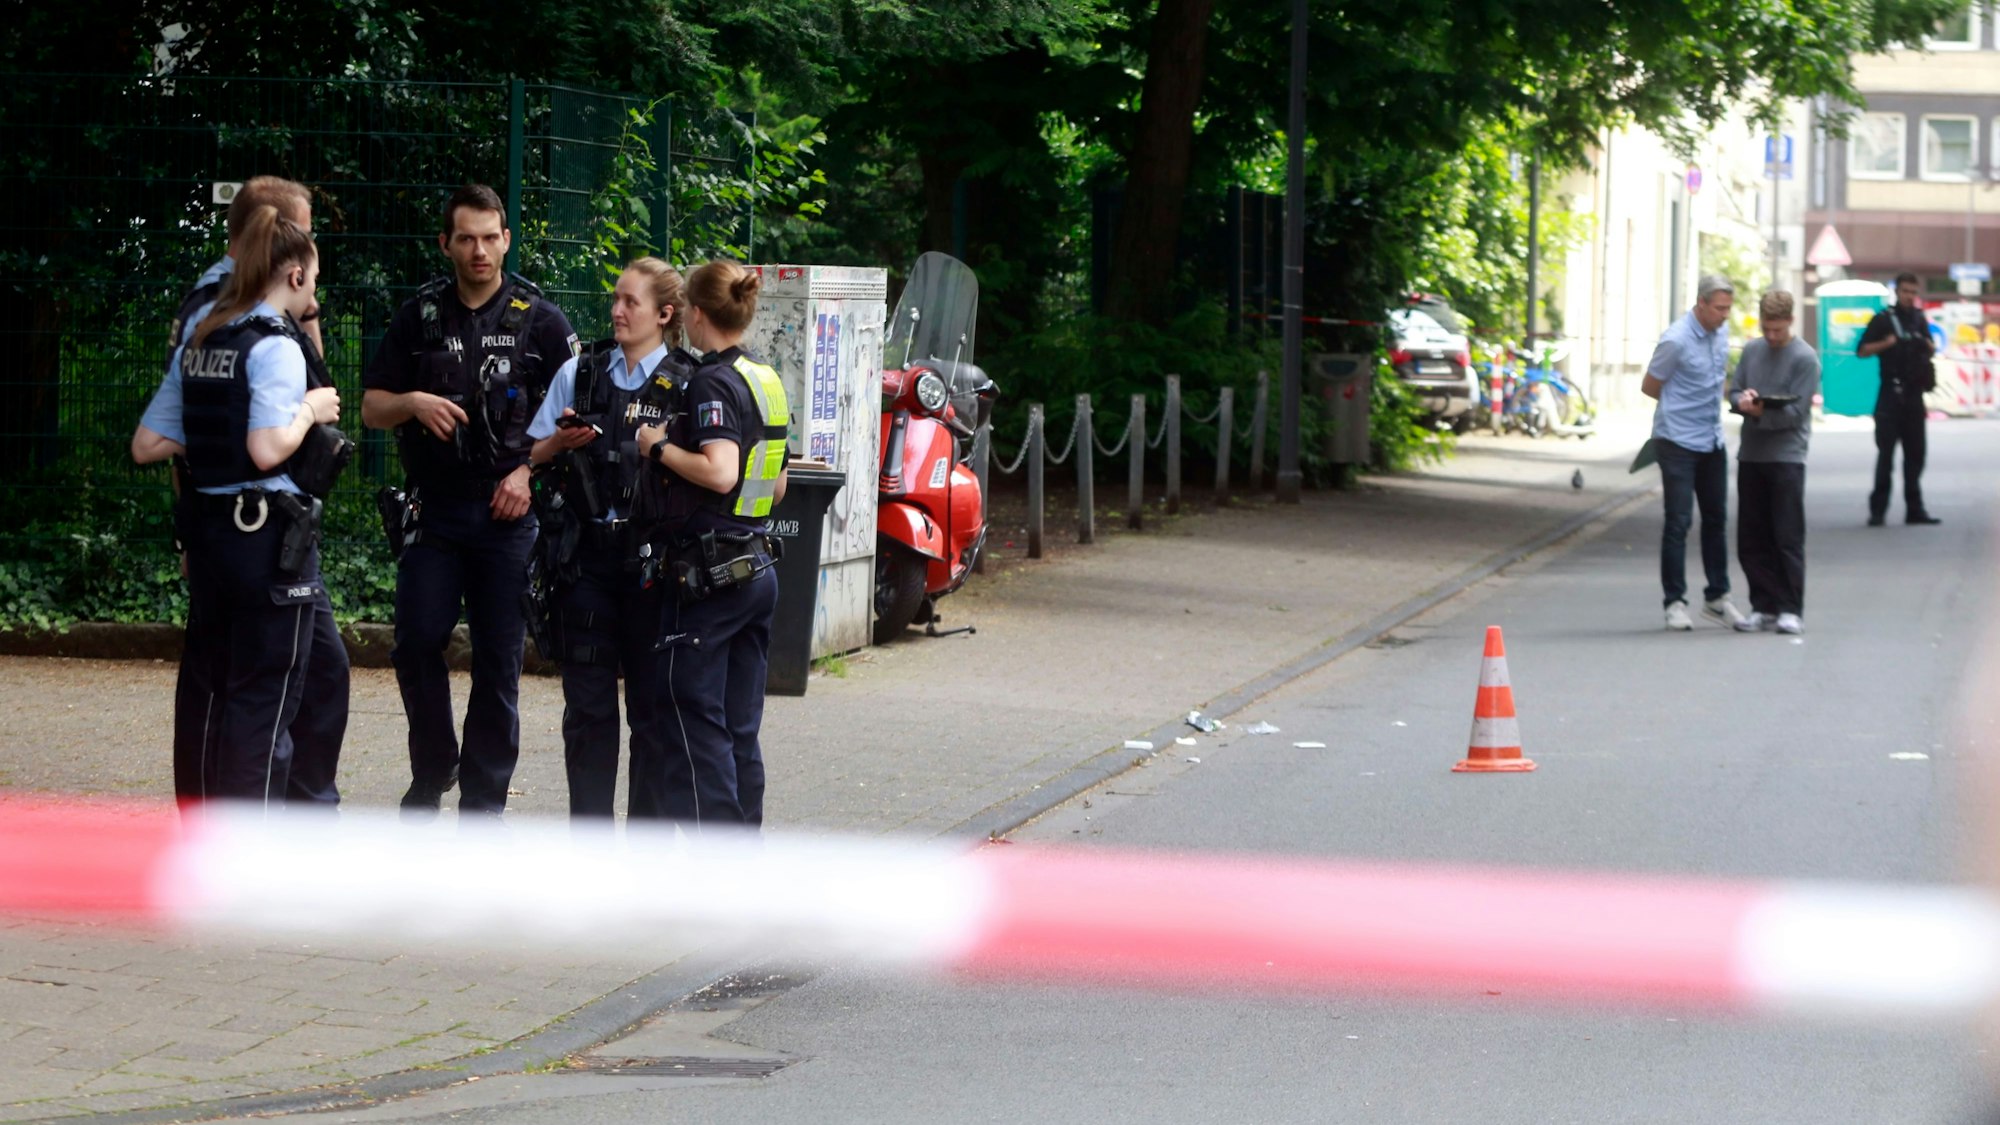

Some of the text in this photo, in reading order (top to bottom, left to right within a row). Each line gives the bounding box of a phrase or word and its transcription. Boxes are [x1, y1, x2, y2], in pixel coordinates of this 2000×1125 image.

[482, 335, 515, 347] POLIZEI
[182, 348, 239, 379] POLIZEI
[775, 520, 799, 533] AWB
